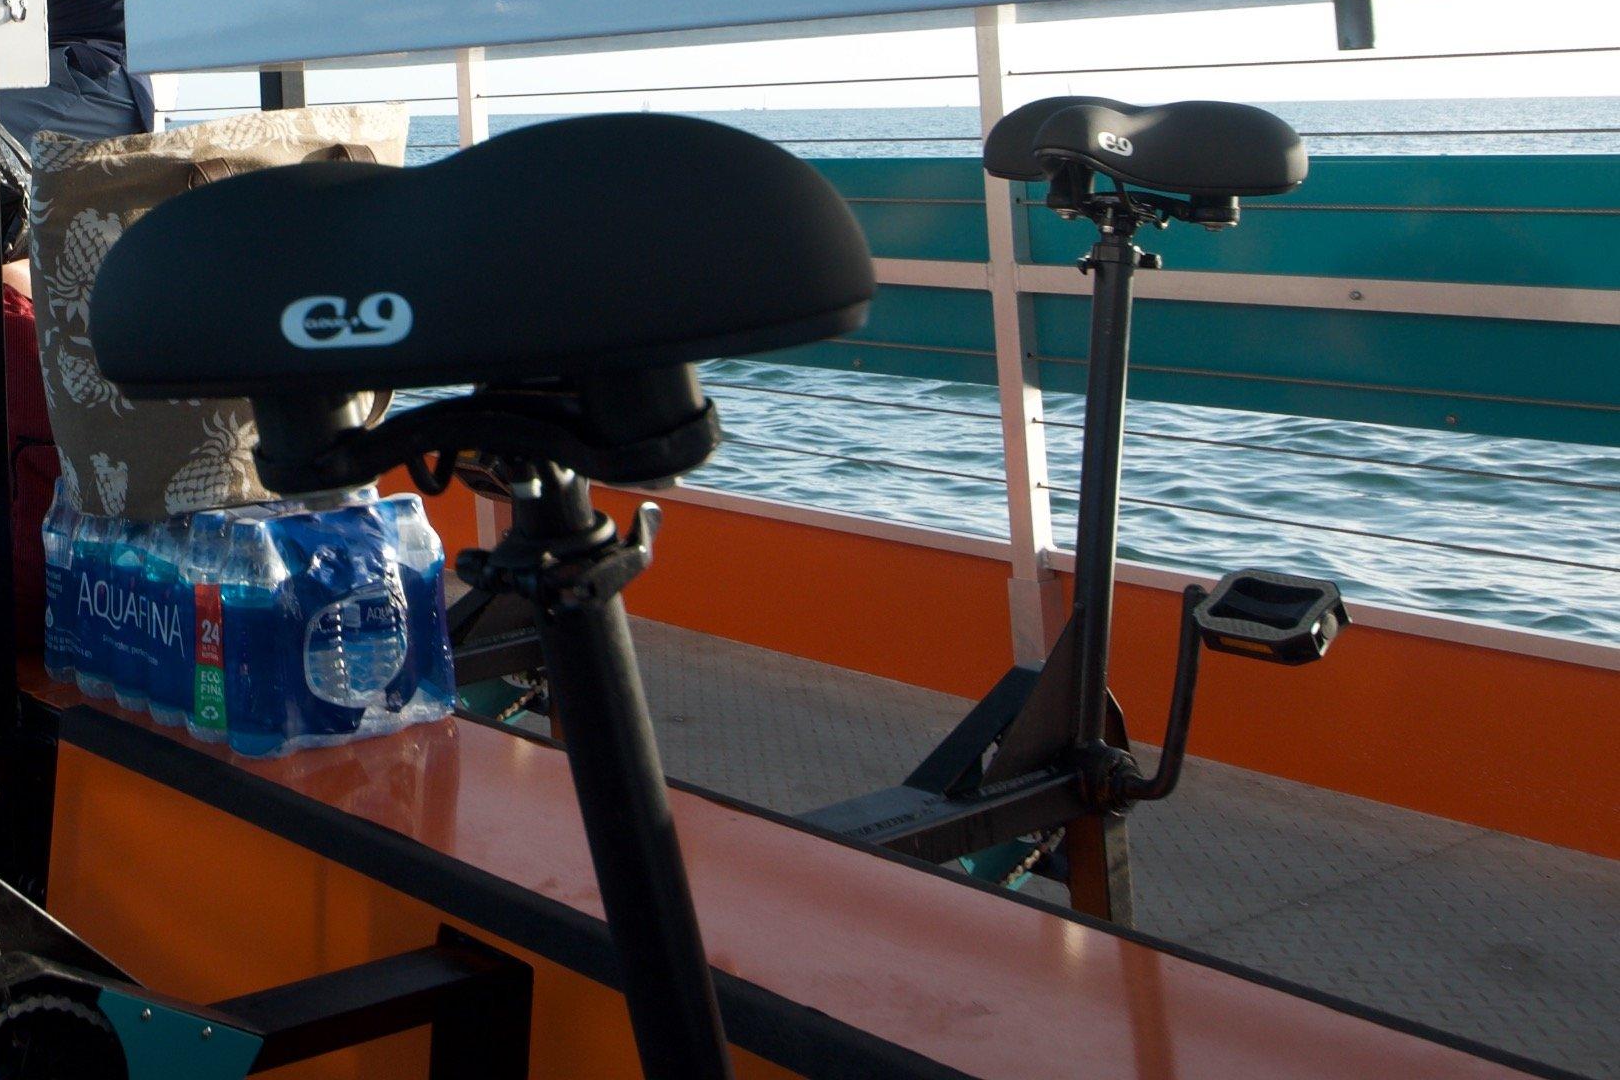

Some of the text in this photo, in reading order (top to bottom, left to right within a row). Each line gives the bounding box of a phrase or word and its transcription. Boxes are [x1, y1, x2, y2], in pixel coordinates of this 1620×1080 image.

[78, 571, 185, 658] AQUAFINA
[201, 619, 220, 646] 24
[201, 670, 220, 684] ECO
[201, 684, 223, 698] FINA
